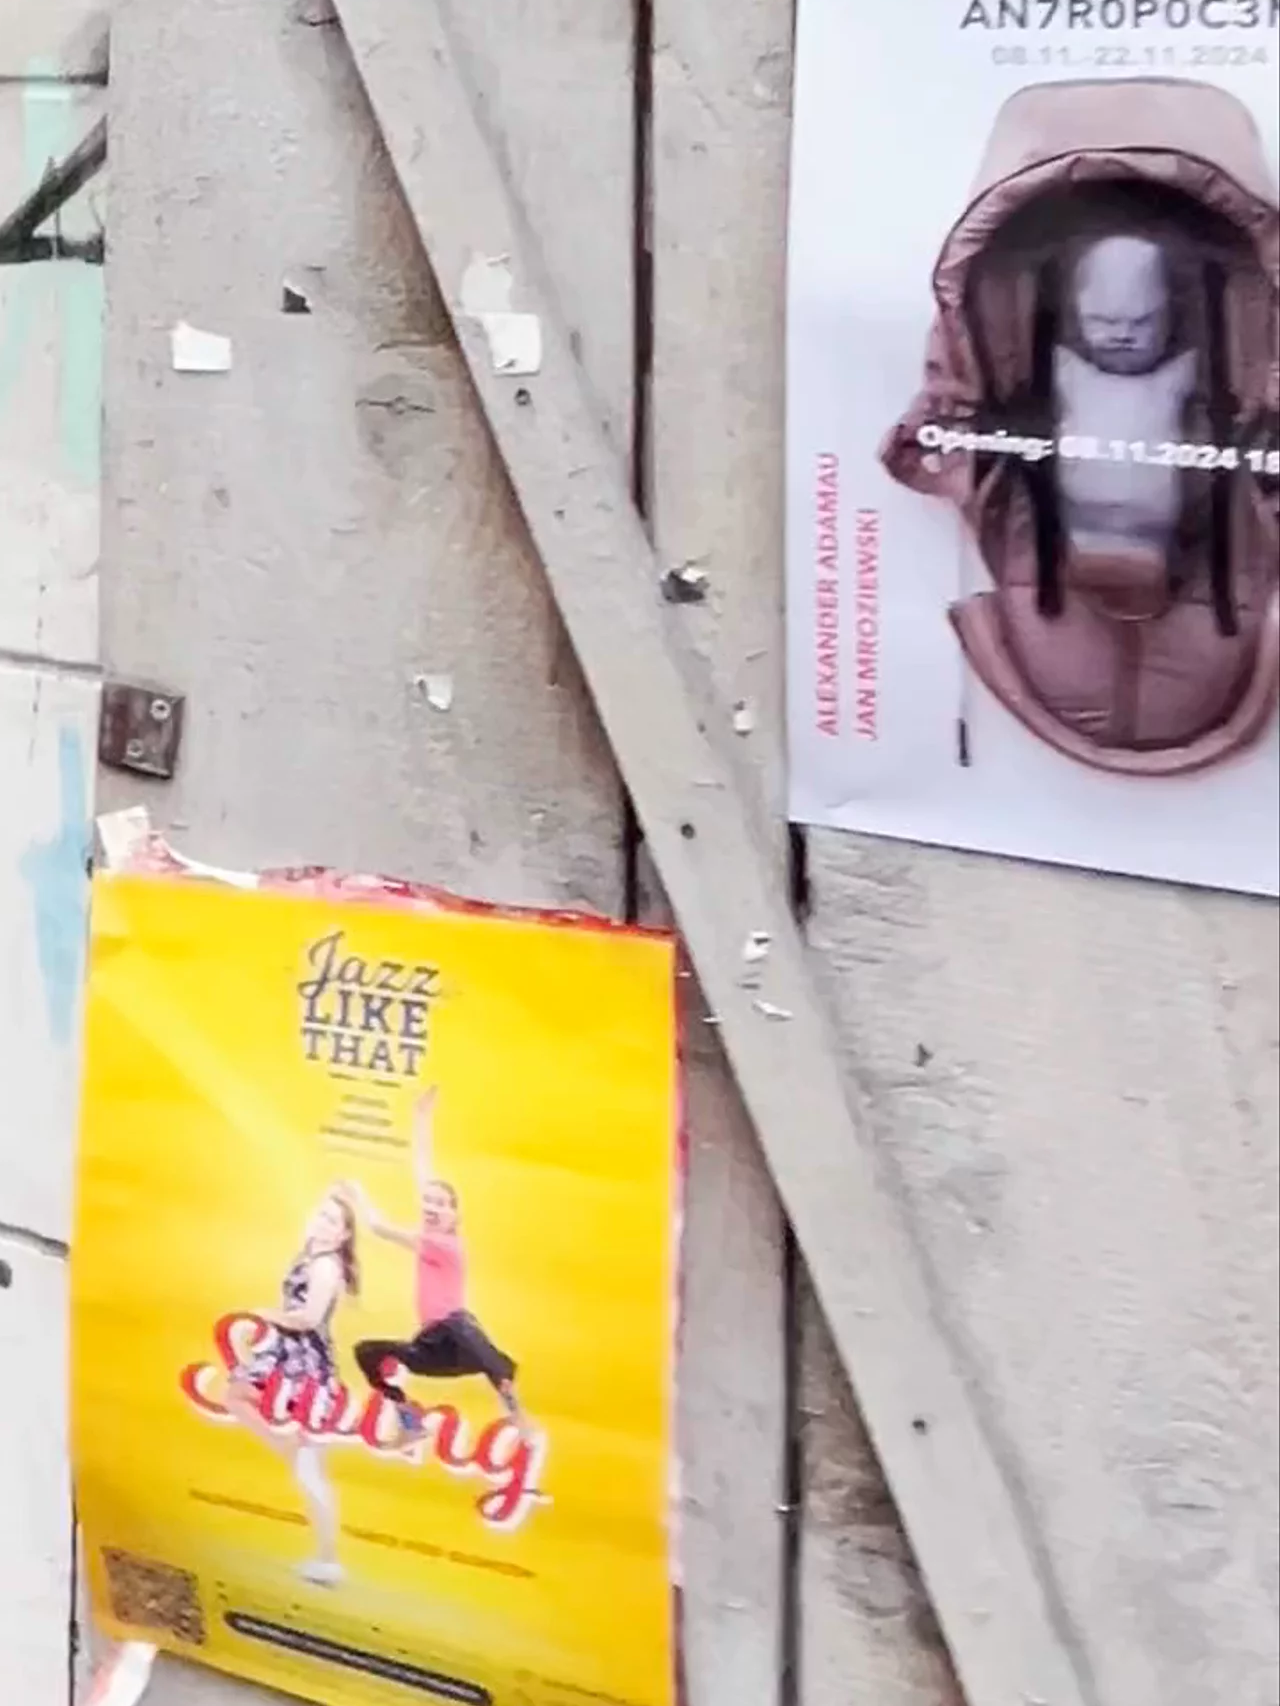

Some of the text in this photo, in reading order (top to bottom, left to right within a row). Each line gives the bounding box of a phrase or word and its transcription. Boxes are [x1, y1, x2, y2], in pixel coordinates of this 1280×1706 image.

[816, 452, 840, 736] ALEXANDER ADAMAU
[855, 508, 880, 741] JAN MROZIEWSKI
[297, 930, 442, 1001] Jazz
[304, 988, 429, 1041] LIKE
[301, 1027, 427, 1077] THAT
[178, 1312, 546, 1524] Swing
